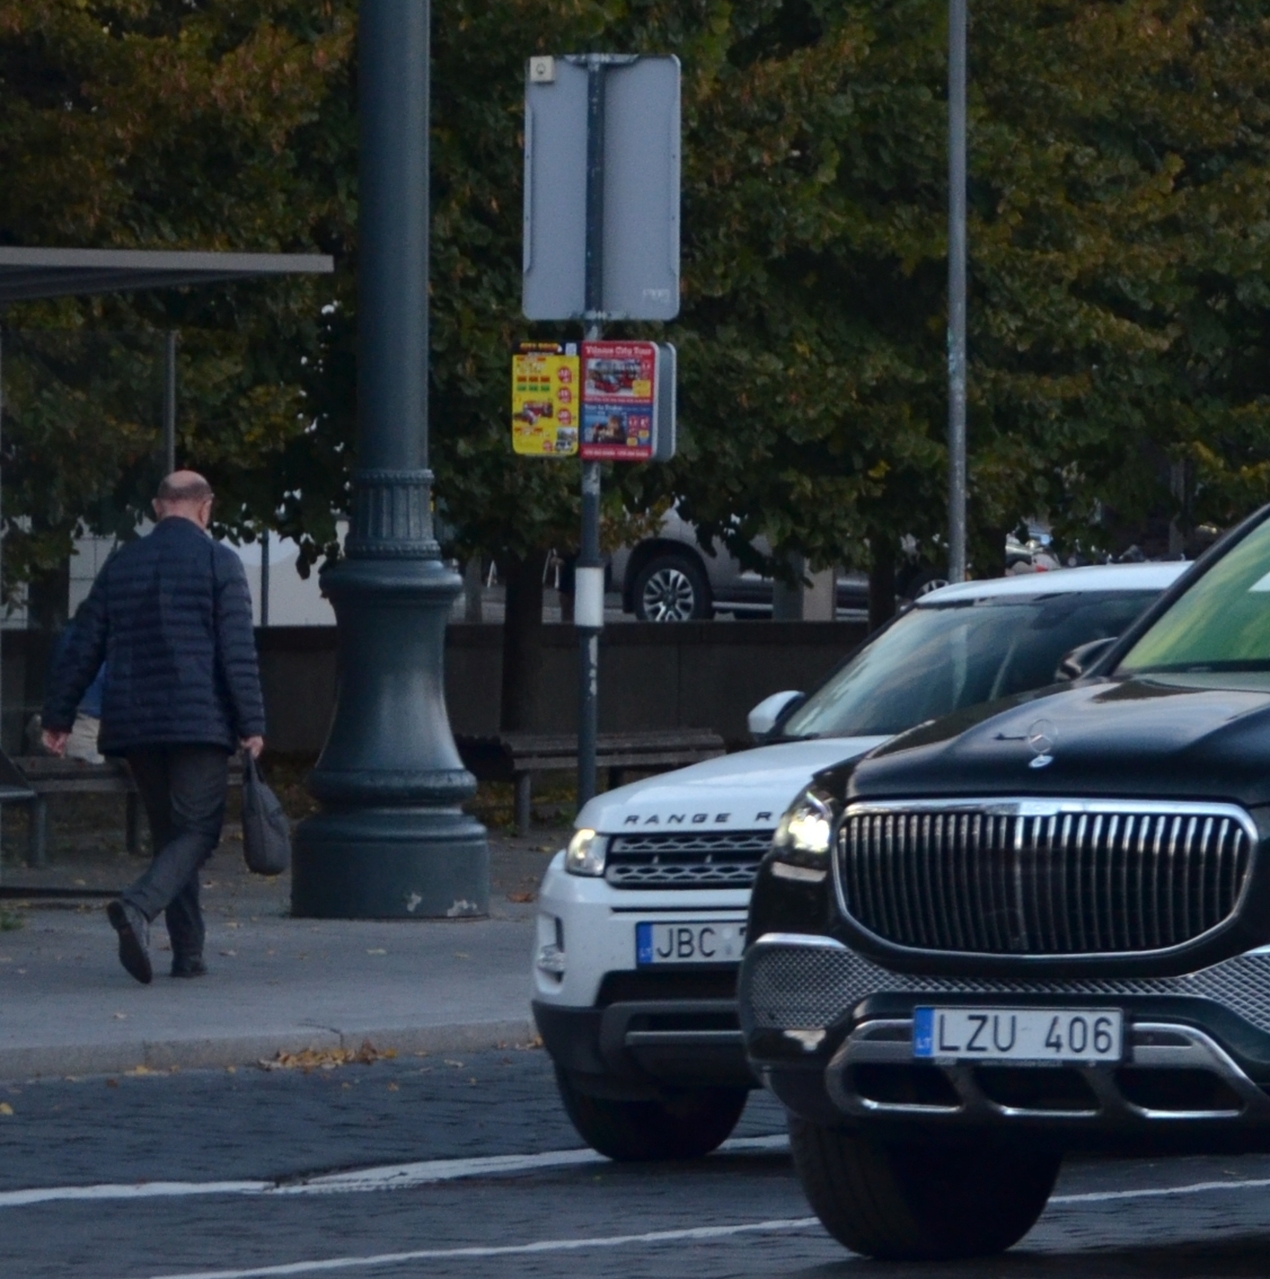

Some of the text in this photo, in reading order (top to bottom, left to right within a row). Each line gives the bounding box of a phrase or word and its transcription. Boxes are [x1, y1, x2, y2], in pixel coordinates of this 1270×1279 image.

[615, 346, 632, 356] City
[634, 346, 652, 355] Tour
[624, 812, 731, 825] RANGE
[656, 927, 716, 958] JBC
[938, 1014, 1016, 1052] LZU
[1045, 1016, 1113, 1053] 406
